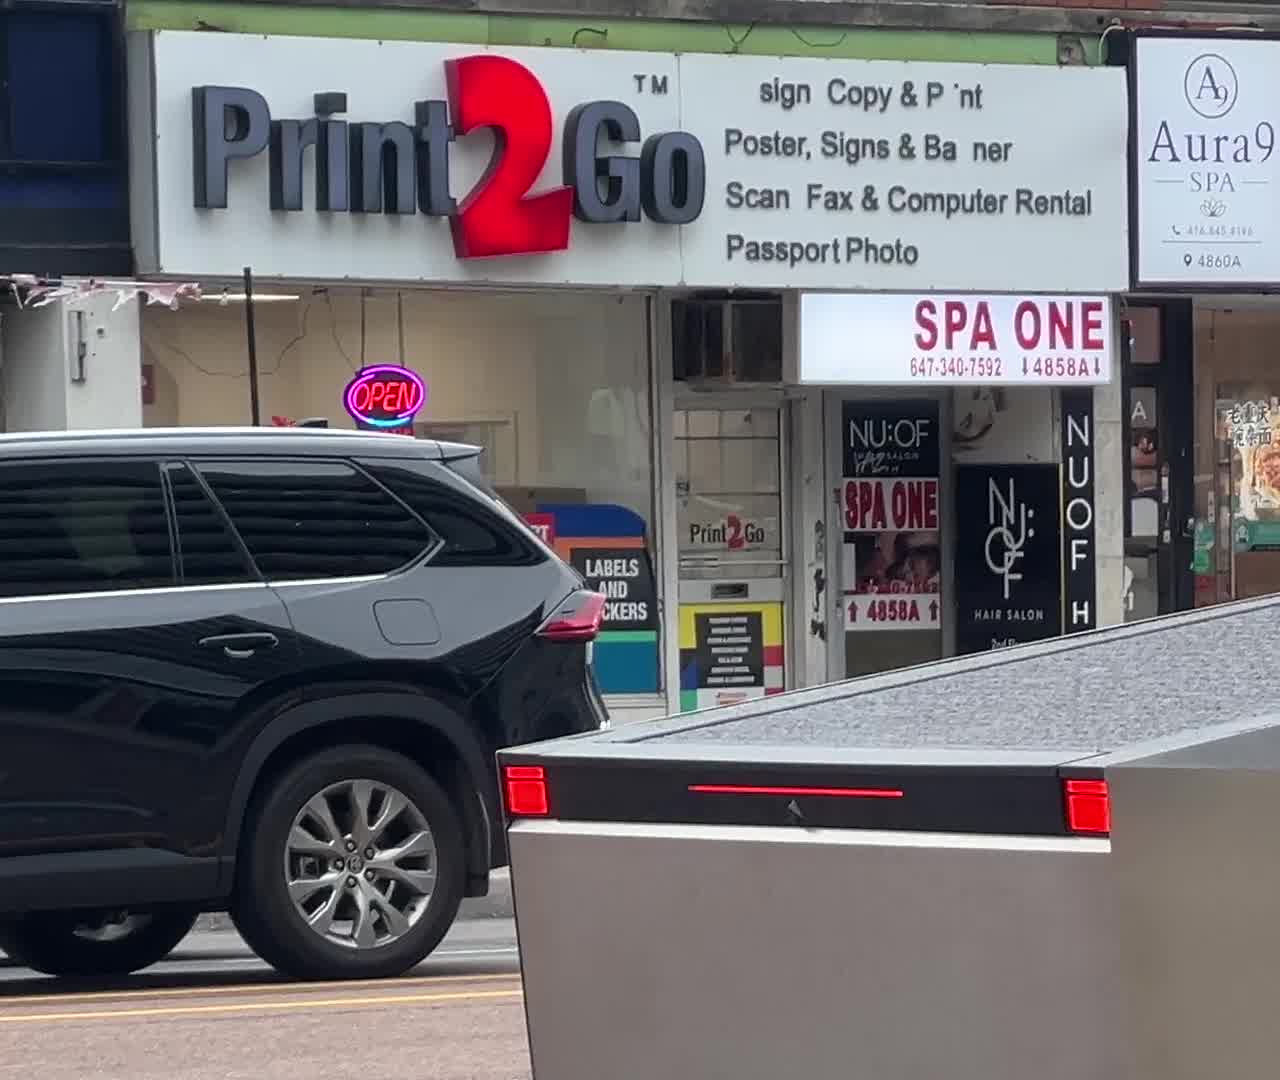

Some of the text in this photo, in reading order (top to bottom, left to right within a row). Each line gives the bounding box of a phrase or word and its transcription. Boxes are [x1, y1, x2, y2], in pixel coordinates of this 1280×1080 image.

[827, 78, 893, 113] Copy
[901, 80, 918, 107] &
[192, 54, 705, 258] Print2Go
[724, 128, 1013, 164] Poster, Signs & Baner
[1149, 120, 1275, 163] Aura9
[1190, 172, 1235, 192] SPA
[725, 182, 1092, 219] Scan Fax & Computer Rental
[726, 234, 919, 268] Passport Photo
[1198, 254, 1241, 268] 4860A
[914, 301, 1103, 351] SPA ONE
[910, 358, 1090, 377] 647-340-7592 4858A
[353, 382, 416, 411] OPEN
[1131, 402, 1147, 420] A
[850, 420, 929, 448] NU:OF
[844, 481, 937, 529] SPA ONE
[690, 512, 765, 549] Print2Go
[585, 559, 639, 577] LABELS
[598, 581, 627, 598] AND
[602, 602, 647, 620] CKERS
[975, 609, 1043, 621] HAIR SALON
